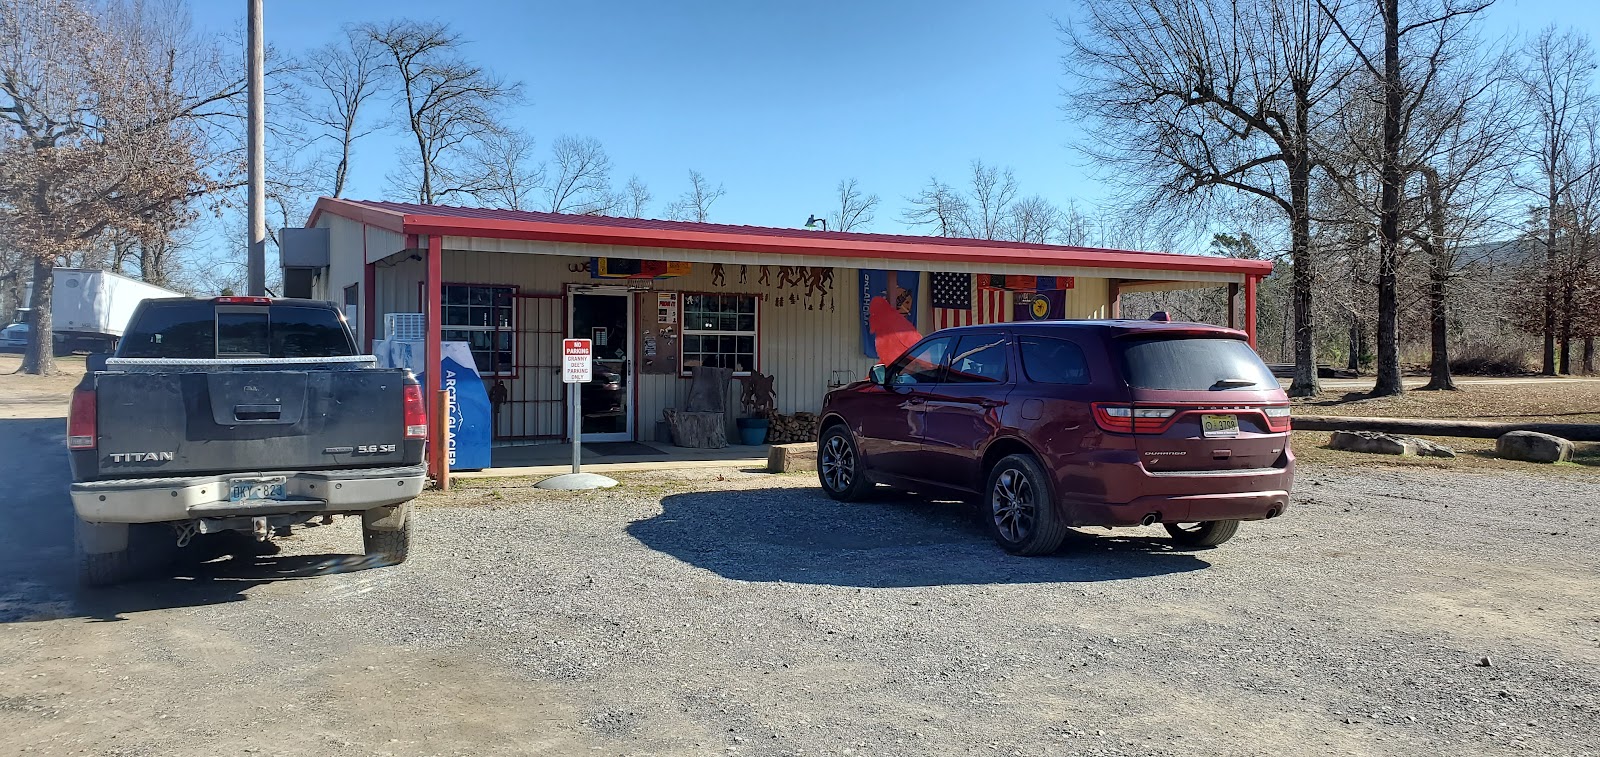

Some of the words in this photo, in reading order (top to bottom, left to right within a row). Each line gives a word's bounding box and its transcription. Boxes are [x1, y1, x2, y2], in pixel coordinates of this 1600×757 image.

[862, 274, 871, 326] OKLAHOMA
[446, 370, 456, 413] ARCTIC
[109, 451, 174, 463] TITAN
[358, 445, 378, 453] 5.6
[379, 444, 396, 452] SE
[448, 416, 456, 466] GLACIER
